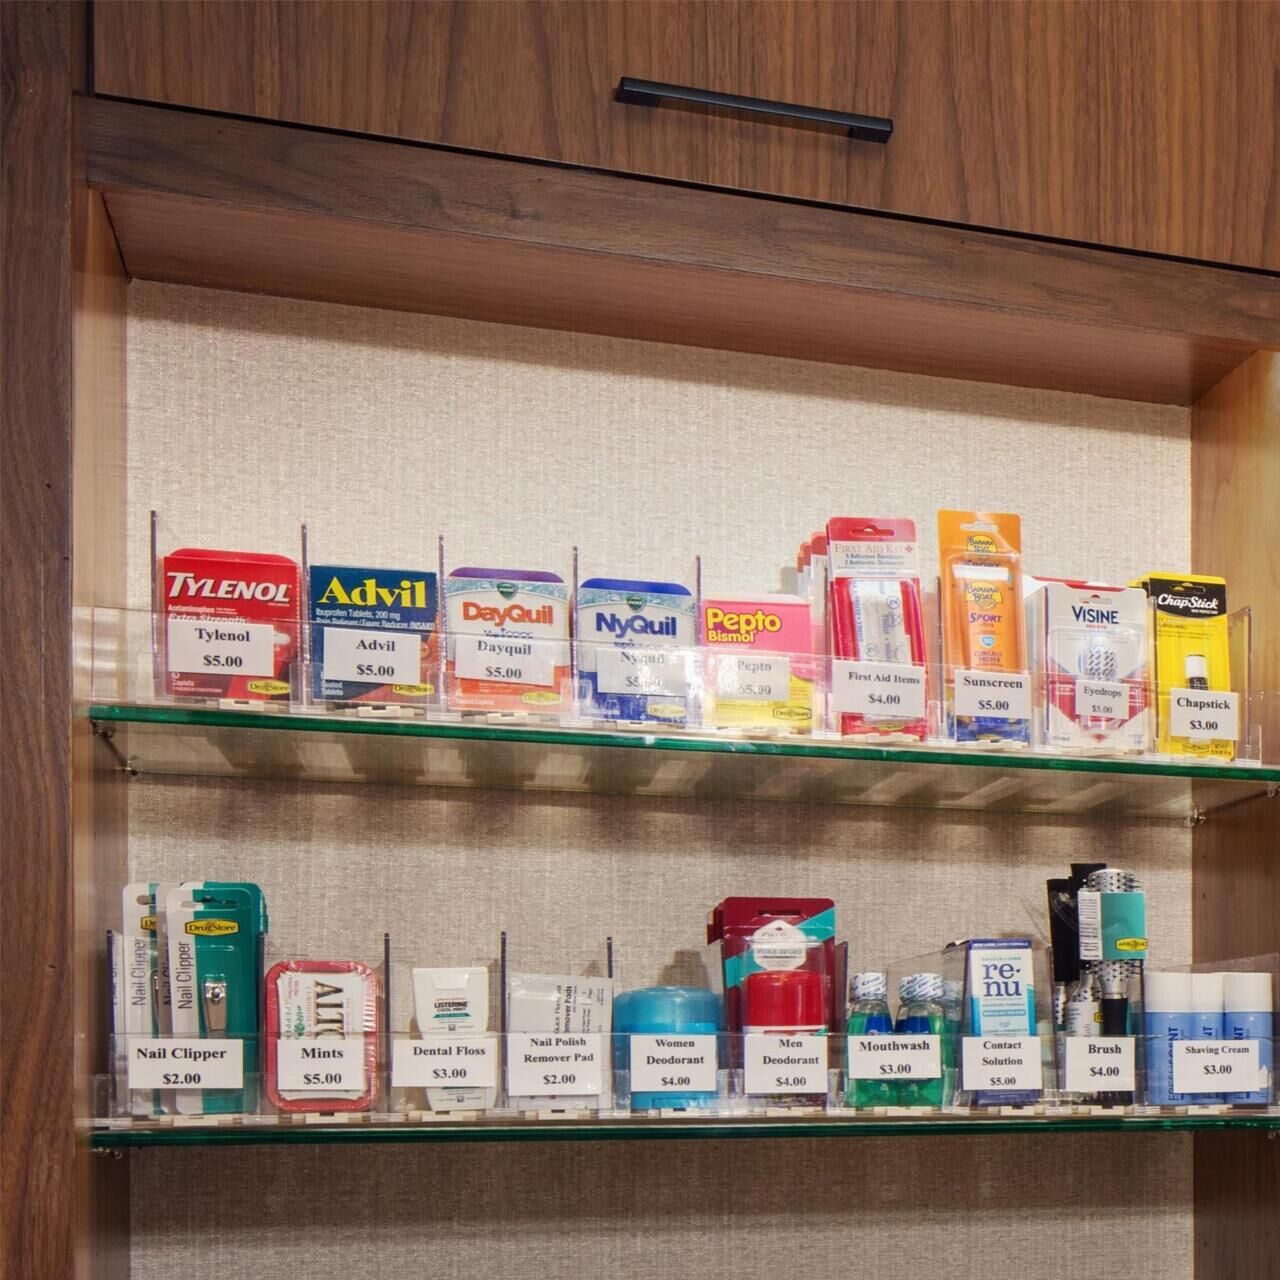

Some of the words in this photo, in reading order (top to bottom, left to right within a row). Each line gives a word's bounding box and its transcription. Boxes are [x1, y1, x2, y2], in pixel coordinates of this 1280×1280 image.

[167, 571, 290, 602] TYLENOL
[319, 577, 426, 608] Advil
[1158, 593, 1218, 610] ChapStick
[462, 602, 553, 627] DayQuil
[968, 613, 1002, 624] SPORT
[1072, 605, 1119, 624] VISINE
[596, 613, 677, 638] NyQuil
[706, 608, 782, 638] Pepto
[195, 628, 250, 642] Tylenol
[707, 630, 754, 643] Bismol
[356, 639, 395, 652] Advil
[478, 639, 532, 656] Dayquil
[203, 656, 242, 668] $5.00
[737, 660, 772, 672] Pepto
[848, 672, 873, 683] First
[875, 673, 894, 683] Aid
[897, 674, 920, 685] Items
[963, 676, 1023, 689] Sunscreen
[1083, 686, 1122, 698] Eyedrops
[1177, 698, 1230, 712] Chapstick
[189, 923, 236, 932] DrugStore
[178, 942, 193, 982] Clipper
[178, 986, 193, 1009] Nail
[530, 1038, 551, 1047] Nail
[555, 1037, 586, 1047] Polish
[656, 1039, 695, 1048] Women
[779, 1039, 803, 1048] Men
[860, 1041, 930, 1051] Mouthwash
[983, 1041, 1022, 1051] Contact
[137, 1048, 166, 1059] Nail
[171, 1048, 226, 1061] Clipper
[301, 1048, 343, 1059] Mints
[413, 1046, 452, 1057] Dental
[456, 1046, 486, 1056] Floss
[1088, 1044, 1121, 1054] Brush
[1185, 1045, 1220, 1056] Shaving
[1221, 1045, 1249, 1054] Cream
[524, 1054, 571, 1063] Remover
[574, 1053, 593, 1062] Pad
[646, 1055, 704, 1065] Deodorant
[982, 1056, 1023, 1067] Solution
[162, 1073, 201, 1084] $2.00
